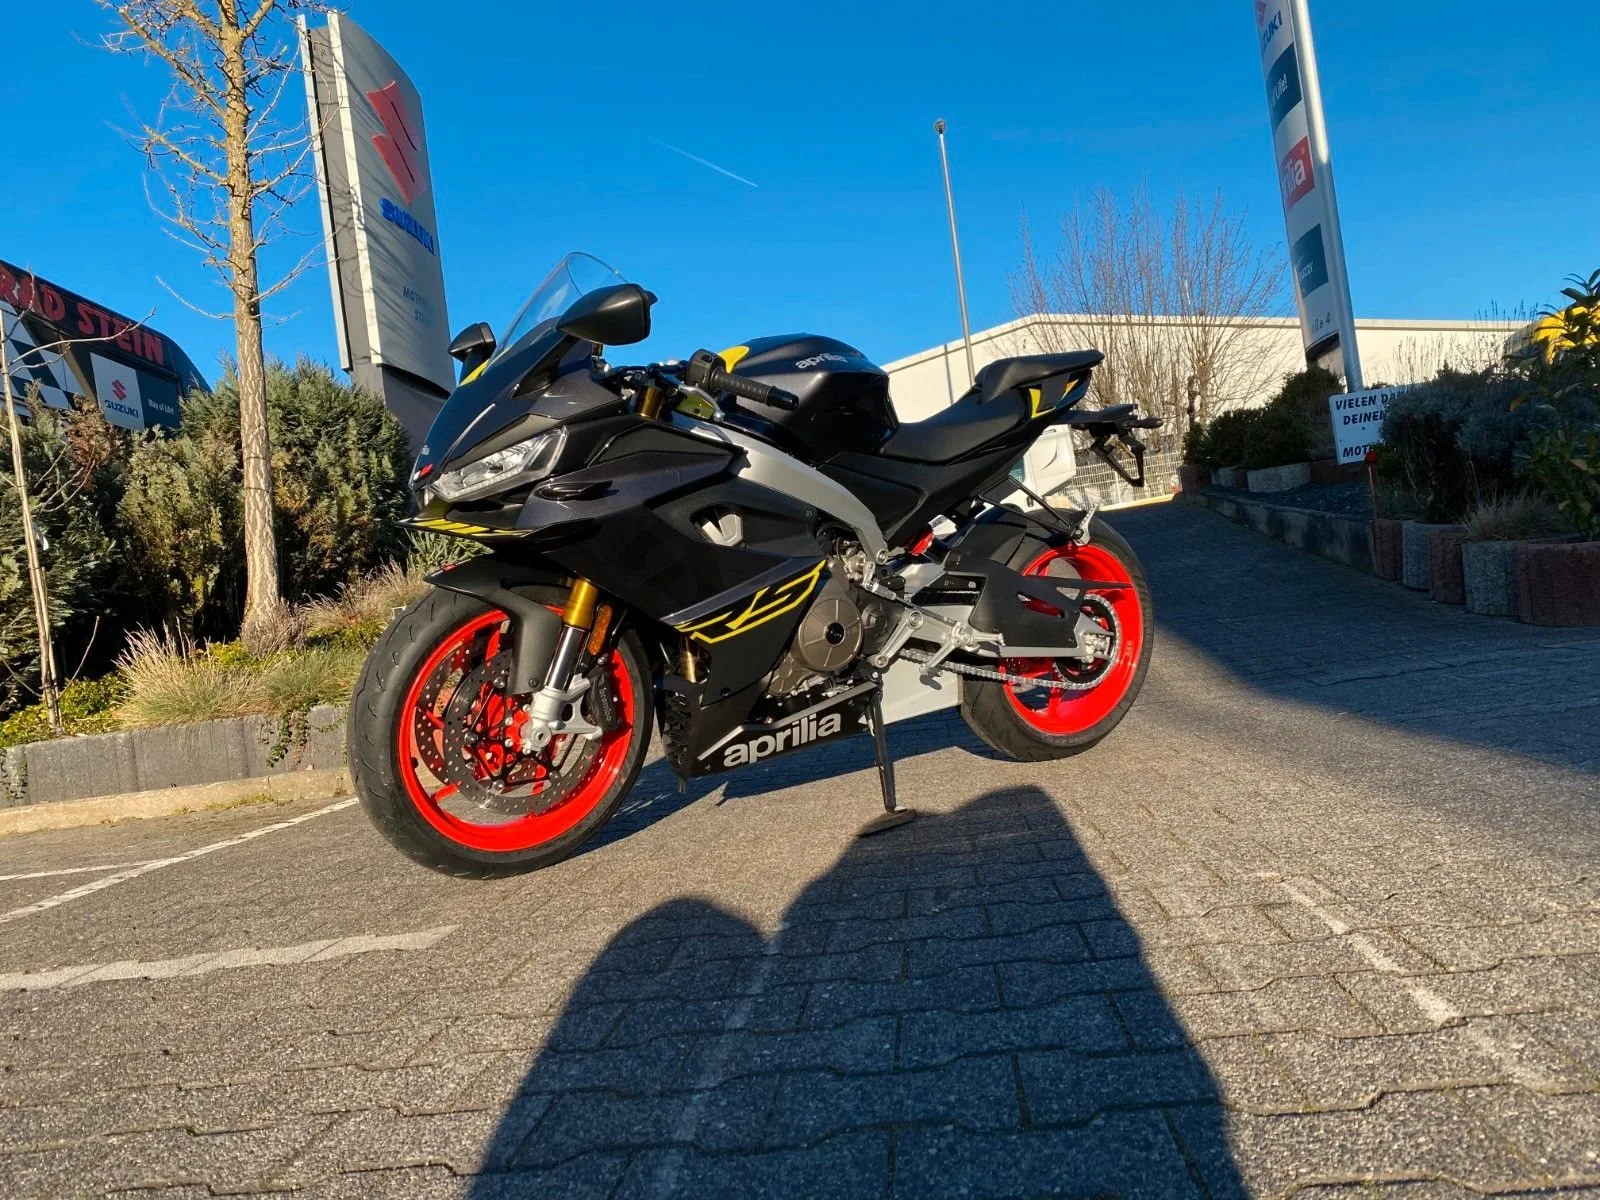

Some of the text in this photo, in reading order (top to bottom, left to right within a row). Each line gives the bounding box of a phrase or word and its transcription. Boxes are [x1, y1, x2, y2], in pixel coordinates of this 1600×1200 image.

[380, 197, 436, 256] SUZUKI
[76, 303, 164, 366] STEIN
[795, 353, 848, 369] aprilia
[105, 399, 139, 418] SUZUKI
[1335, 395, 1377, 410] VIELEN
[1343, 444, 1371, 457] MOT
[723, 712, 841, 767] aprilia
